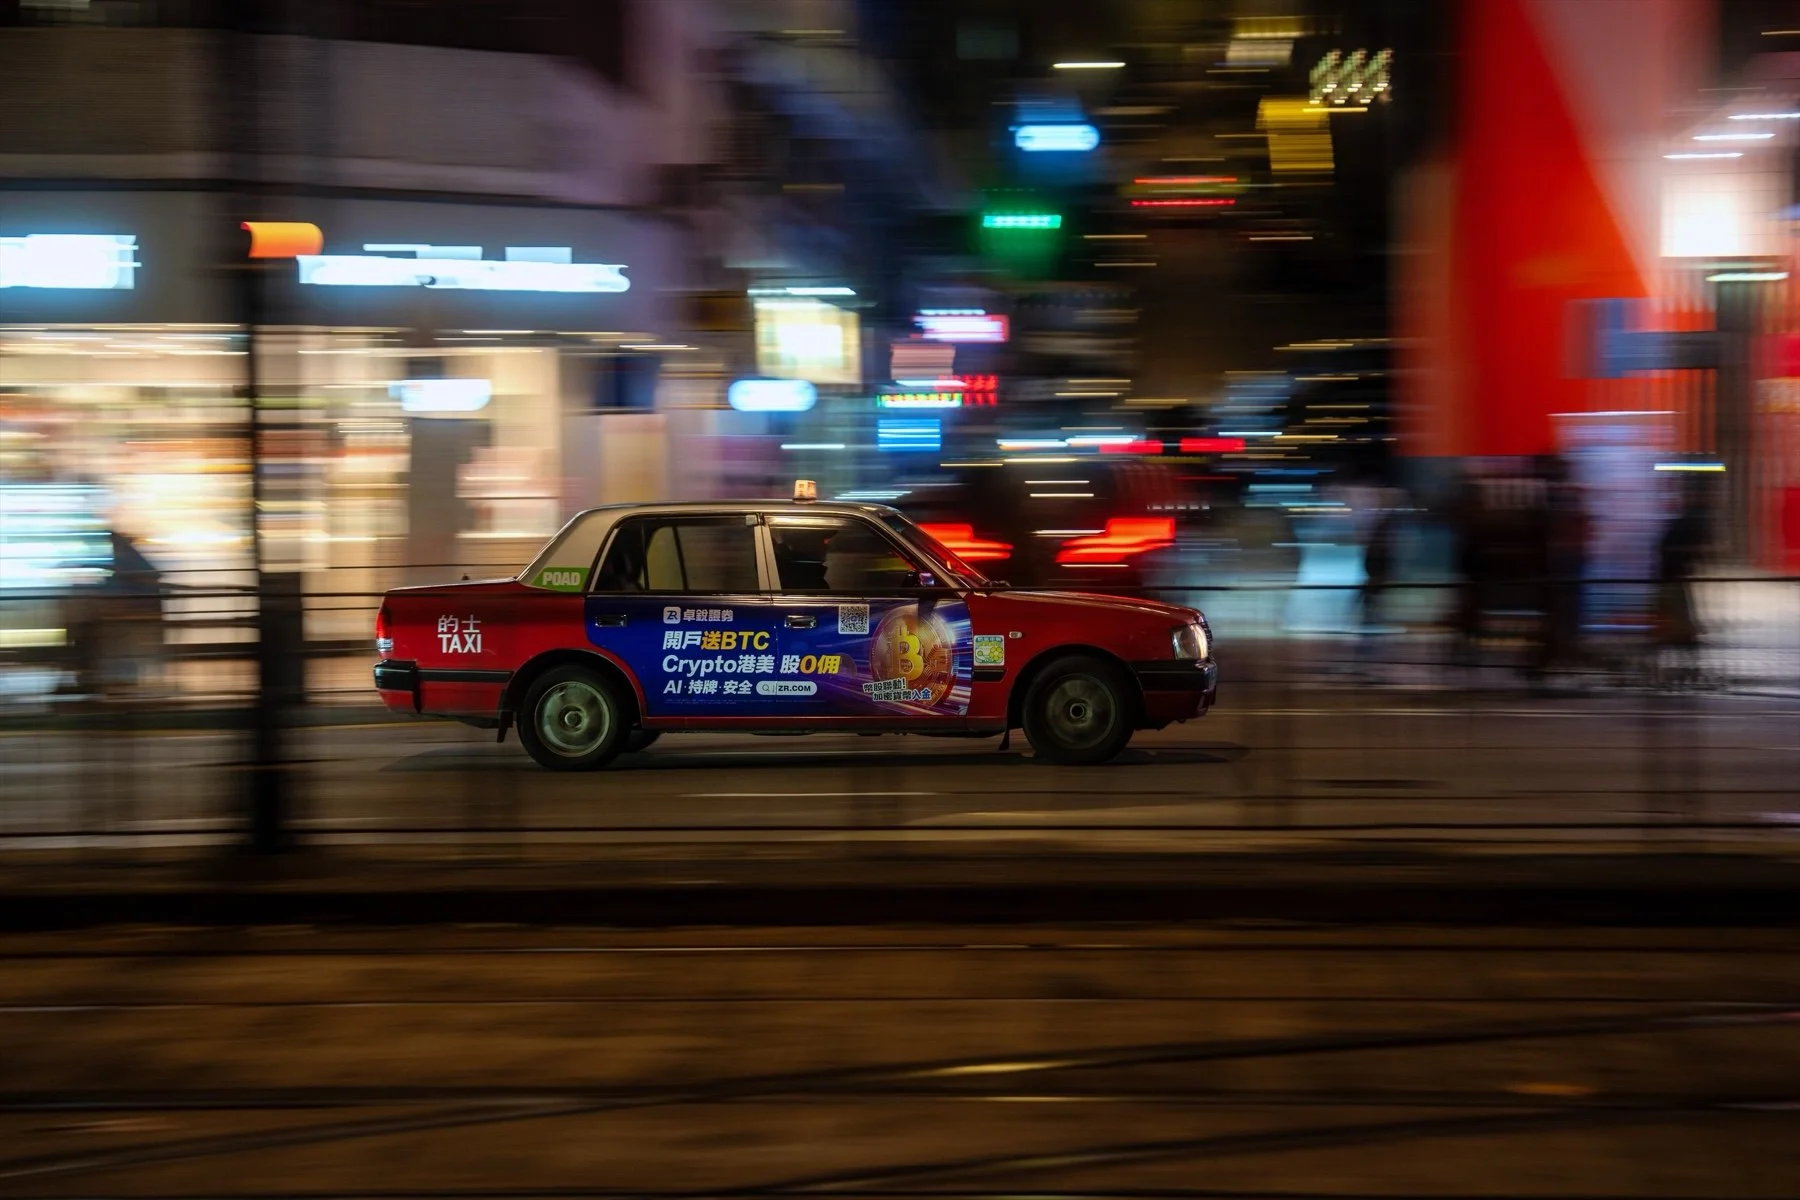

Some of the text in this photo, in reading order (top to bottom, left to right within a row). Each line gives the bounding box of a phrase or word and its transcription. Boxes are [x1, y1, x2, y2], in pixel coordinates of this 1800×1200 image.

[543, 571, 581, 586] POAD
[437, 614, 482, 633] 的士
[437, 634, 482, 653] TAXI
[662, 631, 770, 651] 開戶送BTC
[777, 684, 811, 693] ZR.COM
